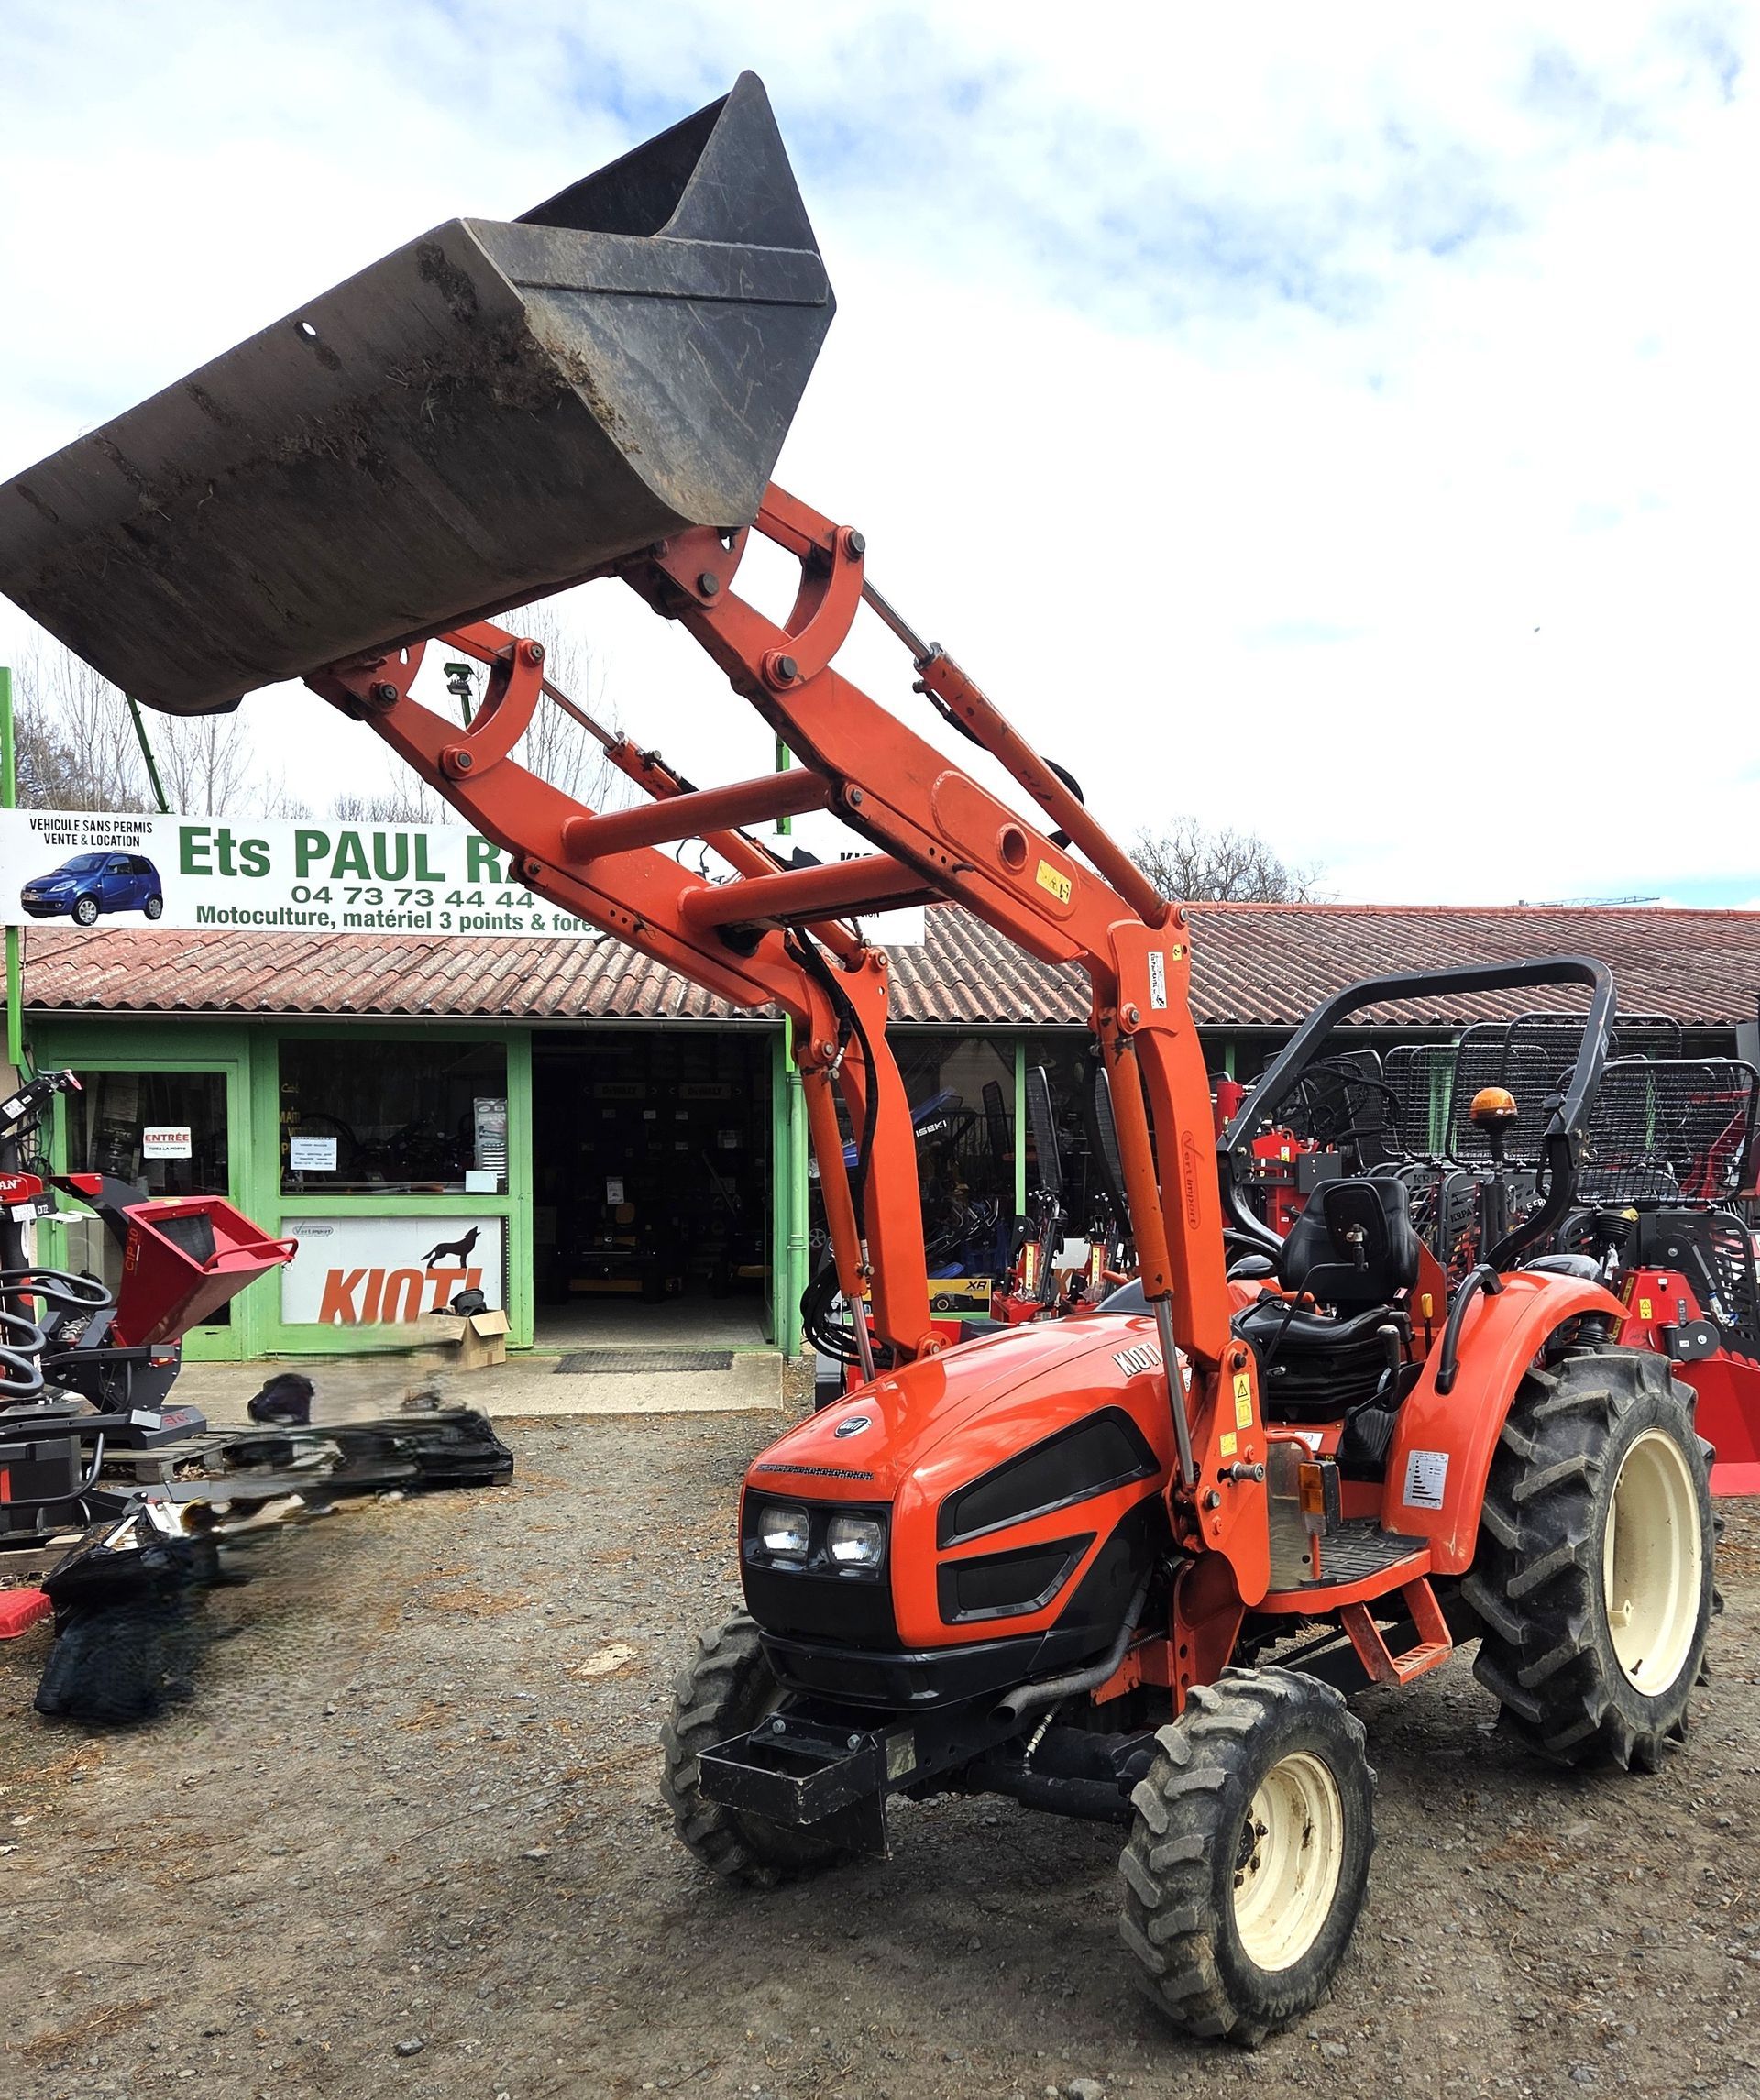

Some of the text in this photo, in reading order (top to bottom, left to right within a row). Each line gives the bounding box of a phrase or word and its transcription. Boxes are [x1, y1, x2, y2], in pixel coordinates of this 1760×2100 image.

[29, 818, 153, 833] VEHICULE SANS PERMIS
[44, 832, 140, 847] VENTE & LOCATION
[179, 826, 517, 883] Ets PAUL R
[291, 885, 535, 908] 04 73 73 44 44
[196, 905, 336, 929] Motoculture,
[343, 909, 432, 928] matériel
[439, 911, 452, 929] 3
[459, 912, 523, 933] points
[531, 913, 545, 930] &
[145, 1132, 189, 1141] ENTRÉE
[916, 1119, 947, 1137] ISEKI
[1111, 1341, 1164, 1378] KIOTI
